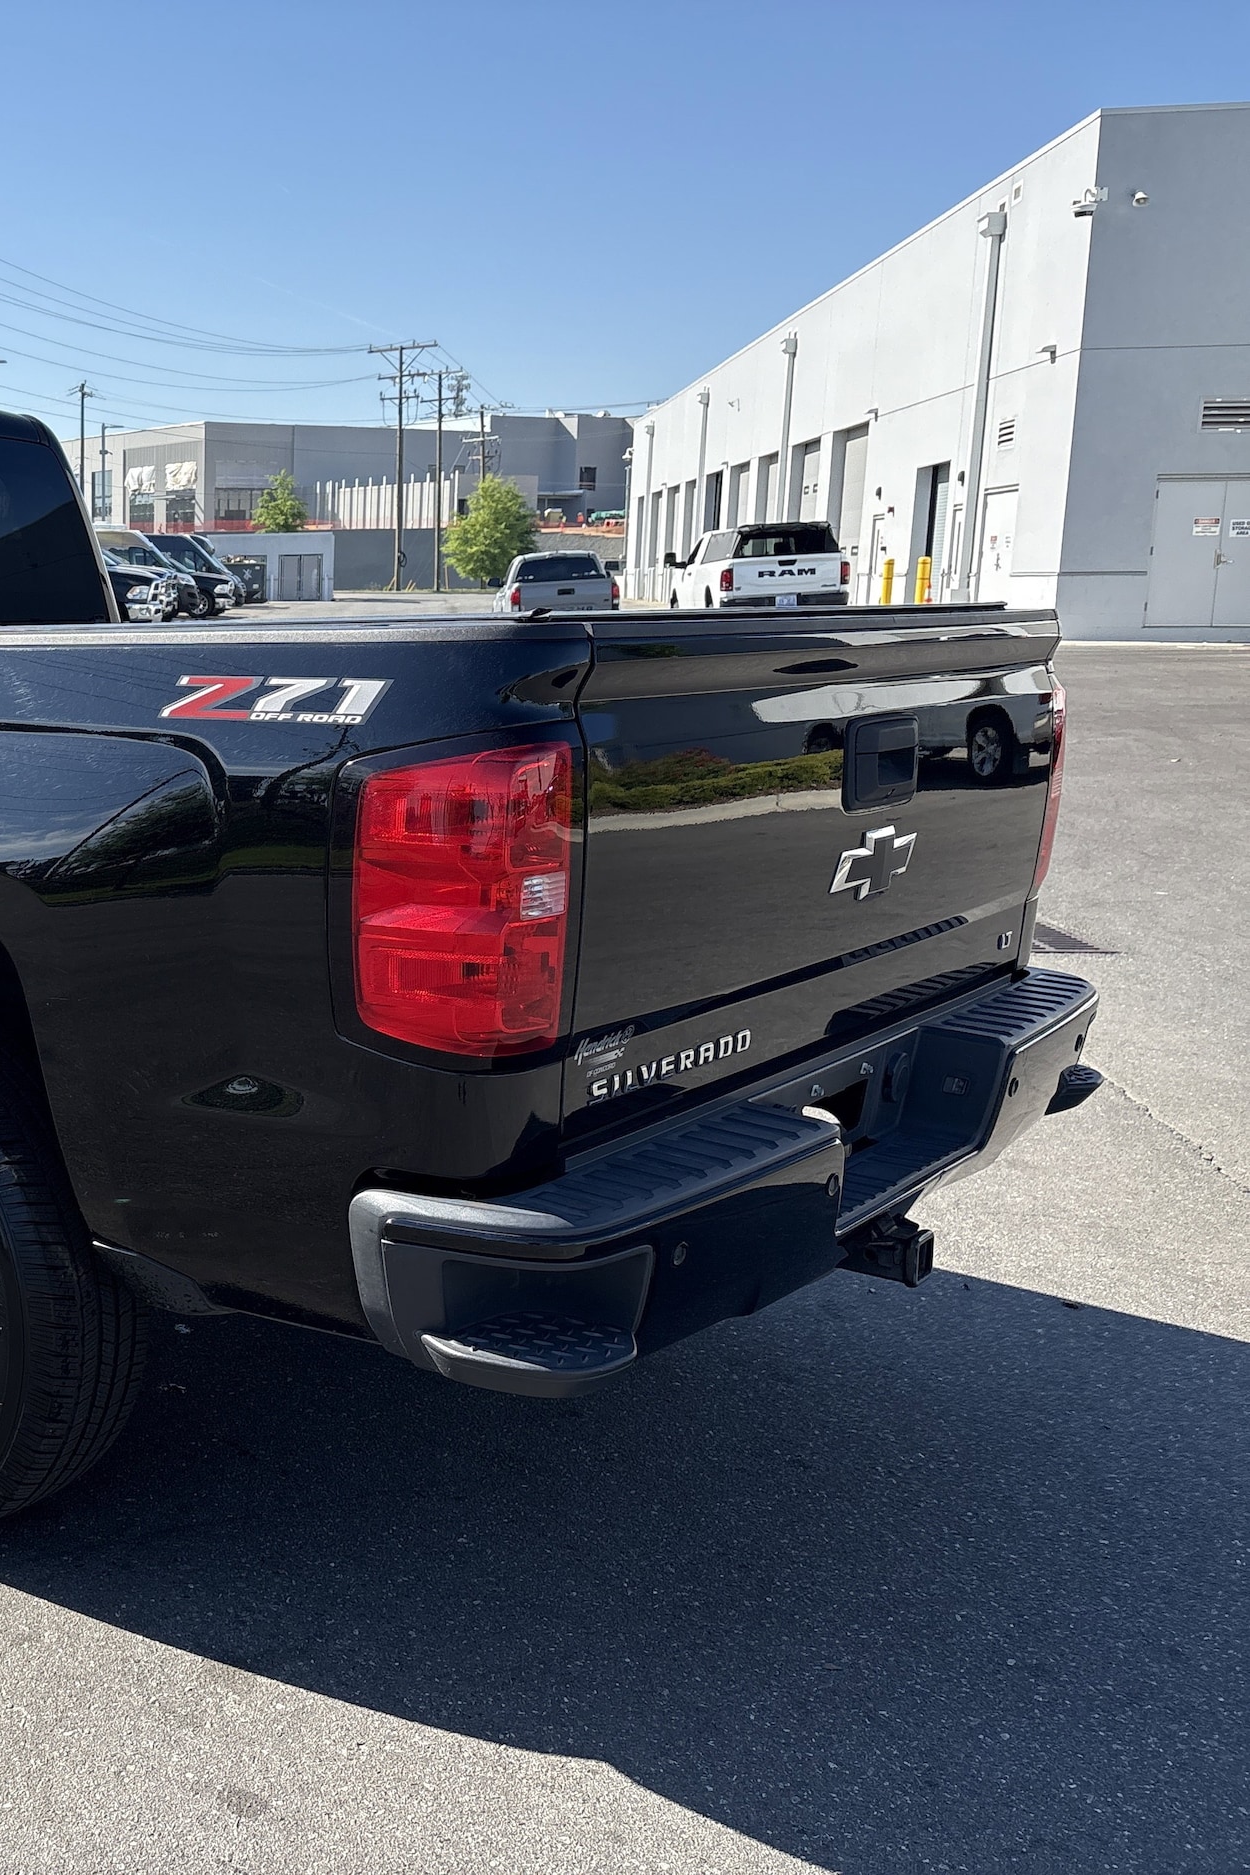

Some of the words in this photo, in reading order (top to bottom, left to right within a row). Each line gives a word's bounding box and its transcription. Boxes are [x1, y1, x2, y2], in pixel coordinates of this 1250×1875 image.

[758, 568, 816, 578] RAM
[158, 675, 395, 719] Z71
[250, 712, 293, 721] OFF
[297, 713, 362, 724] ROAD
[1000, 931, 1013, 949] LT
[590, 1029, 751, 1098] SILVERADO
